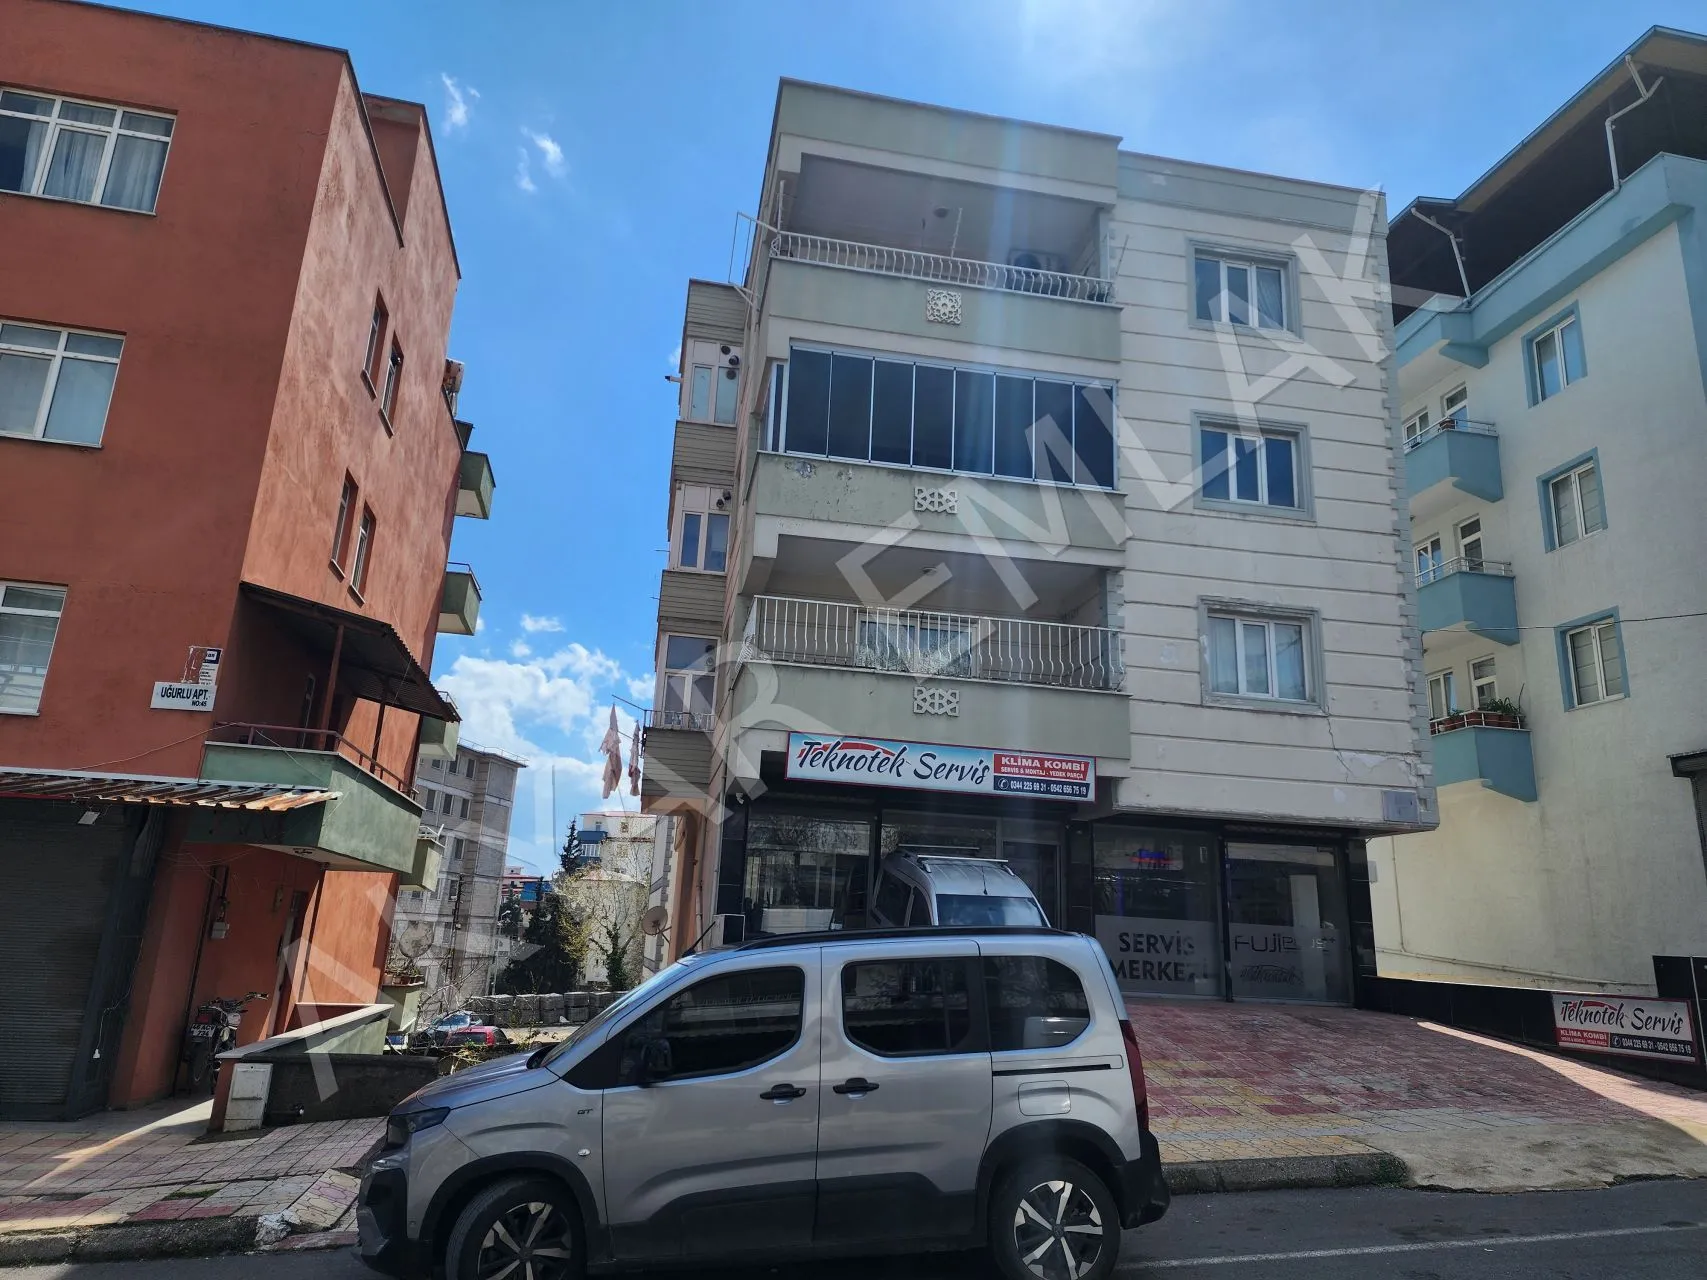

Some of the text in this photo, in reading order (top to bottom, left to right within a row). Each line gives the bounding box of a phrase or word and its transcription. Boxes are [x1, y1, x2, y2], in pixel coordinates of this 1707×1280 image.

[160, 684, 209, 700] UĞURLU APT.
[798, 739, 991, 785] Teknotek Servis
[1001, 756, 1085, 772] KLİMA KOMBİ
[1010, 780, 1022, 789] 0344
[1050, 783, 1062, 793] 0542
[1561, 999, 1684, 1035] Teknotek Servis
